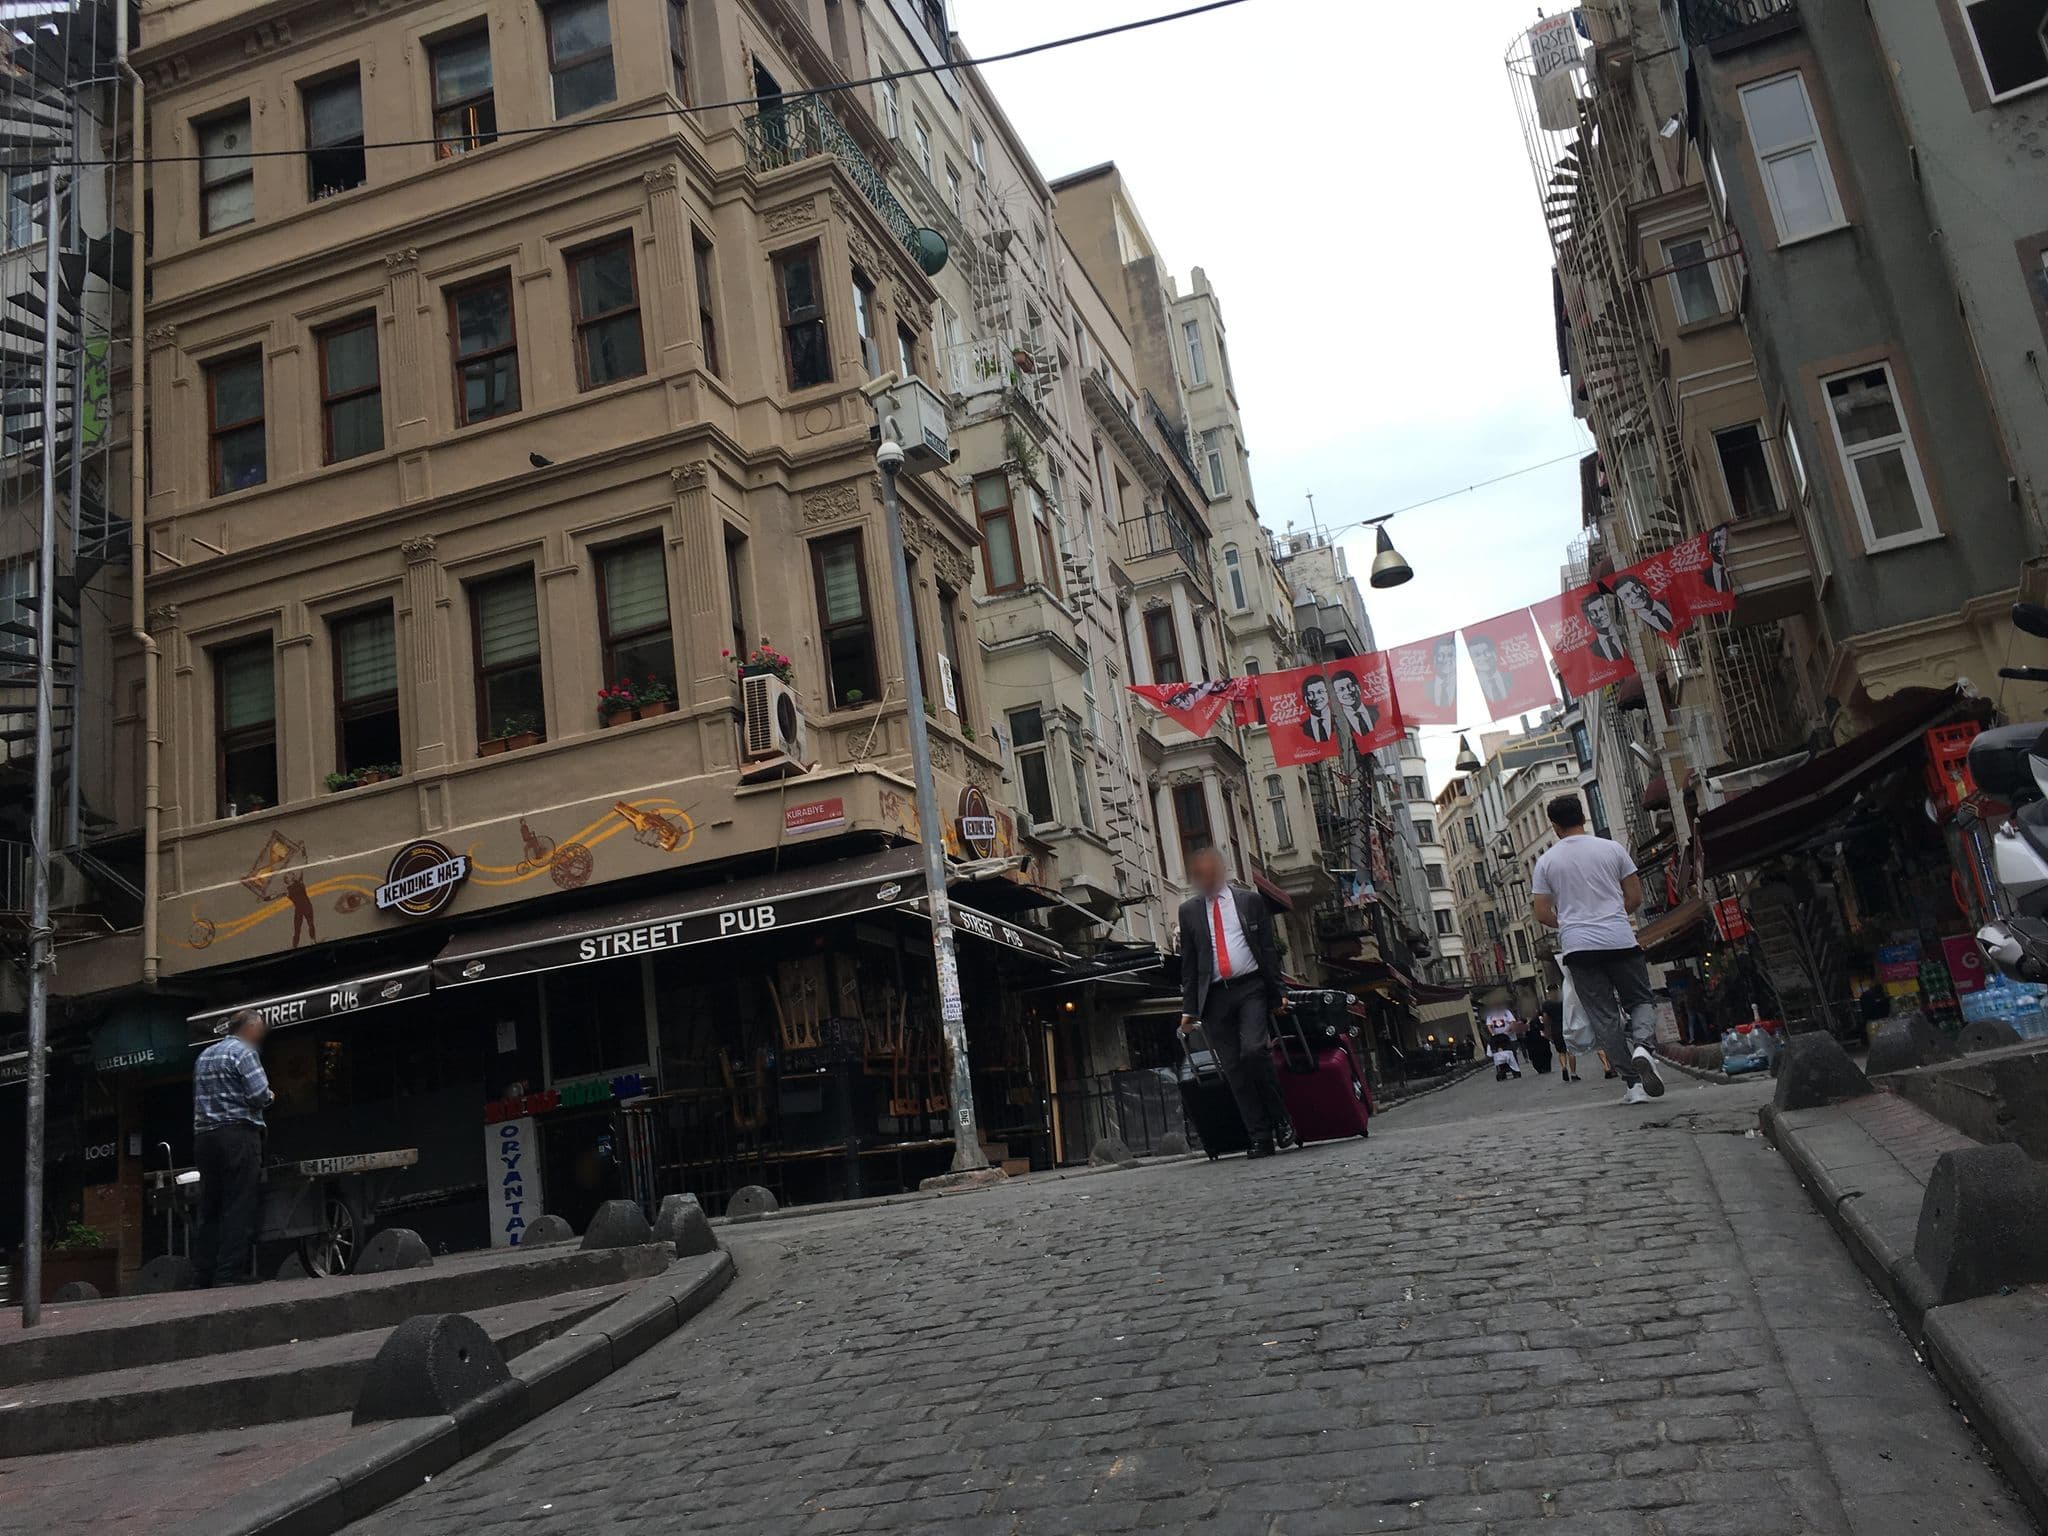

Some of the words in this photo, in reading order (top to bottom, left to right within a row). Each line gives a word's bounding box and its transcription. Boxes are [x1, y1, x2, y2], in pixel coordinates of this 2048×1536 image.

[1532, 26, 1575, 56] ARSEN
[1536, 45, 1578, 77] LUPEN
[786, 804, 825, 820] KURABİYE
[437, 860, 459, 884] HAS
[579, 921, 683, 961] STREET
[719, 904, 776, 935] PUB
[960, 911, 996, 939] STREET
[1002, 927, 1023, 948] PUB
[256, 1000, 308, 1026] TREET
[329, 989, 360, 1014] PUB
[501, 1125, 525, 1247] ORYANTAL
